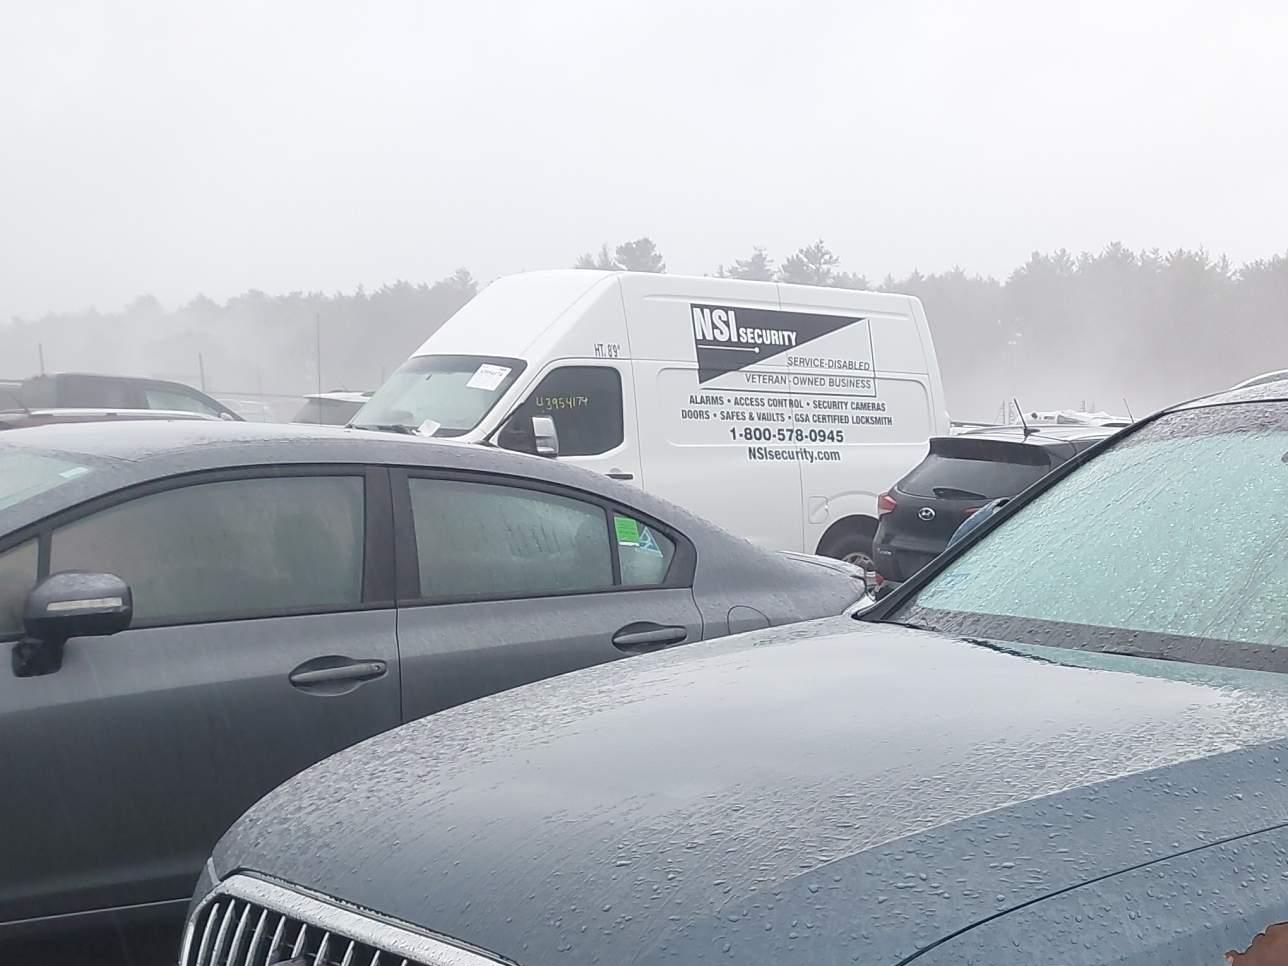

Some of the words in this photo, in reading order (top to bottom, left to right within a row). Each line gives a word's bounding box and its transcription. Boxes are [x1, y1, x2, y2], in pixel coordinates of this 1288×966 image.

[693, 306, 738, 343] NSI
[738, 327, 797, 347] SECURITY
[787, 355, 870, 371] SERVICE-DISABLED
[828, 375, 871, 389] BUSINESS
[689, 395, 725, 406] ALARMS
[733, 396, 766, 407] ACCESS
[767, 398, 804, 409] CONTROL
[812, 400, 849, 411] SECURITY
[850, 402, 886, 412] CAMERAS
[681, 409, 711, 420] DOORS
[720, 410, 747, 421] SAFES
[756, 412, 786, 423] VAULTS
[794, 413, 811, 423] GSA
[812, 414, 850, 425] CERTIFIED
[851, 416, 893, 426] LOCKSMITH
[729, 427, 845, 443] 1-800-578-0945
[748, 447, 841, 463] NSIsecurity.com
